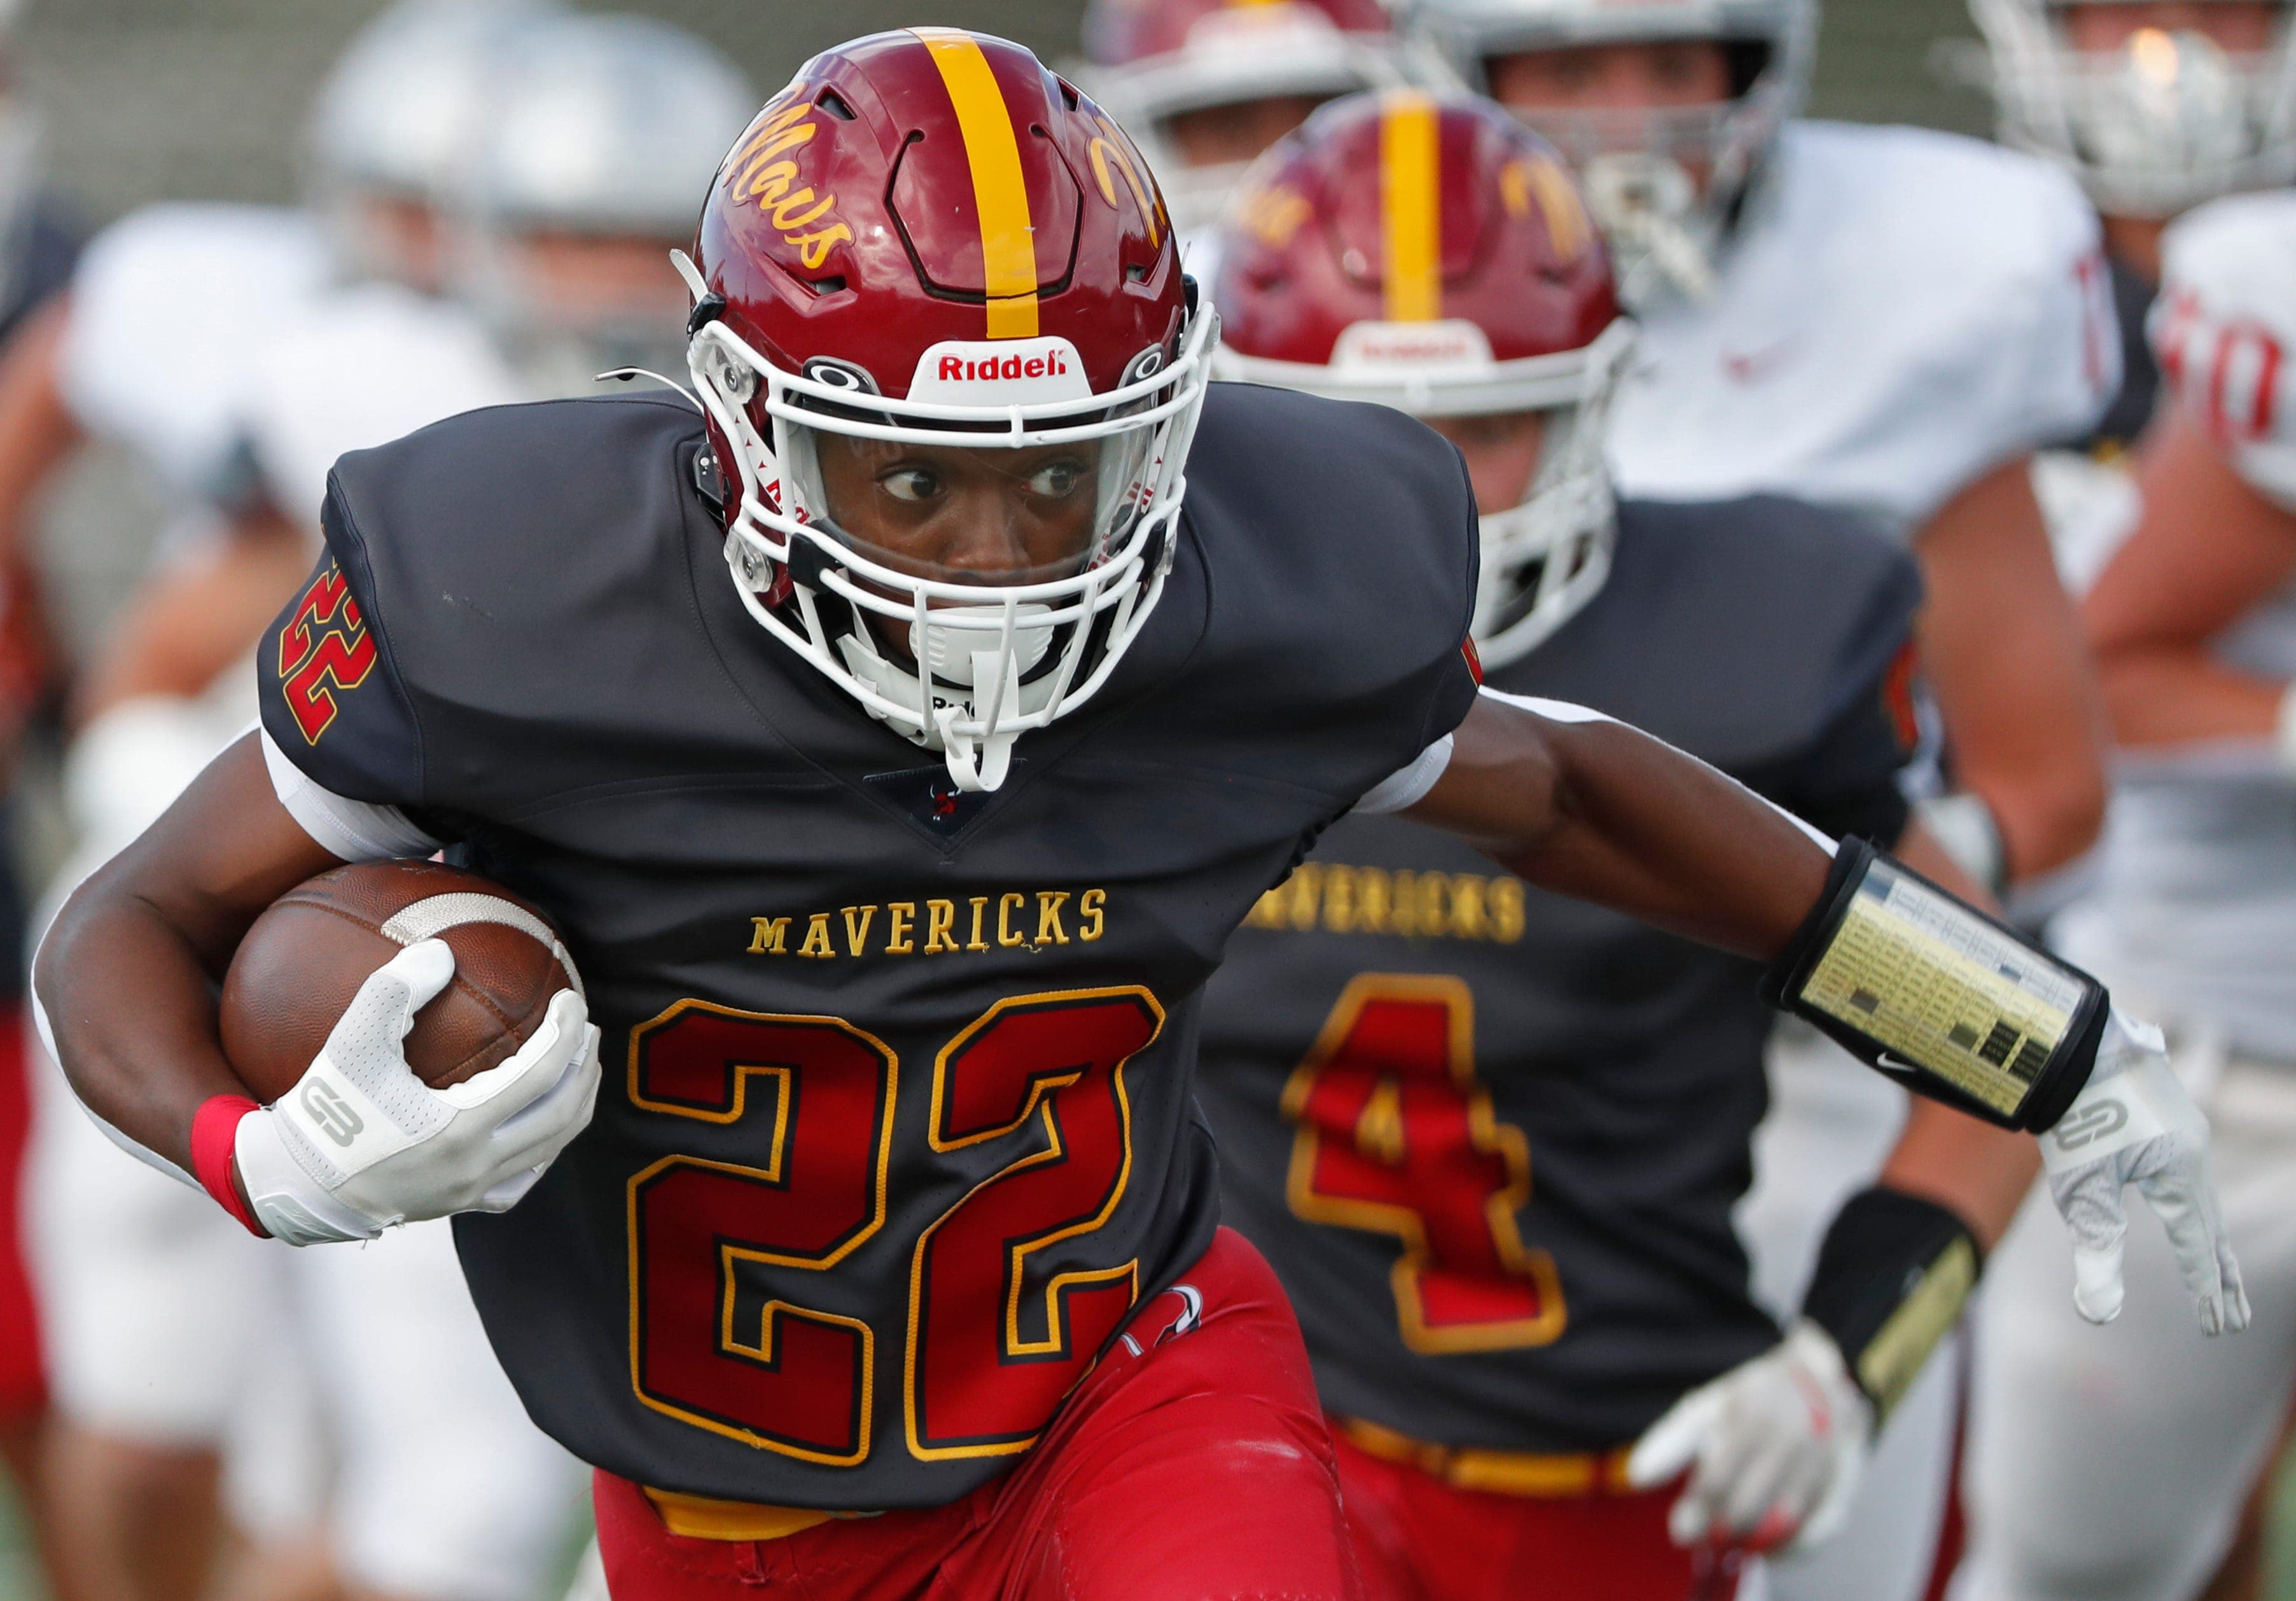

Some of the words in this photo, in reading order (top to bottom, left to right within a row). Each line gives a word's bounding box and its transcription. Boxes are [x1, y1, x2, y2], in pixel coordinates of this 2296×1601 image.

[723, 81, 851, 269] Mavs
[747, 889, 1106, 958] MAVERICKS
[627, 985, 1165, 1467] 22
[1280, 972, 1568, 1355] 4
